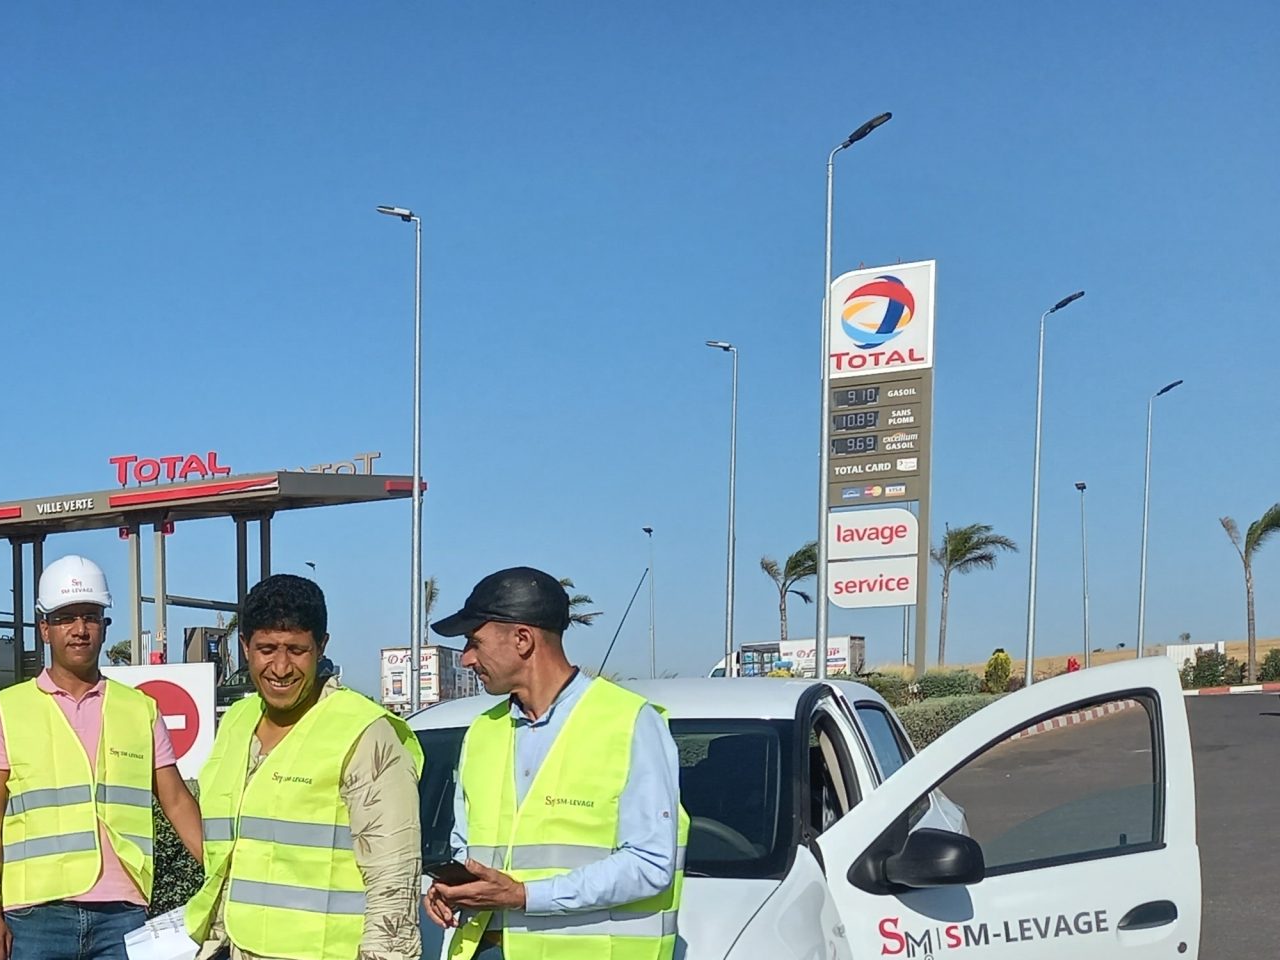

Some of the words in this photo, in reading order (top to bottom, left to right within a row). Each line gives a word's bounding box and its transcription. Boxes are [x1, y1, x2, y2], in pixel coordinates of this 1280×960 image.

[830, 348, 925, 371] TOTAL
[848, 388, 876, 403] 9.10
[887, 387, 917, 398] GASOIL
[888, 416, 915, 425] PLOMB
[891, 408, 912, 418] SANS
[847, 436, 875, 451] 9.69
[885, 441, 914, 450] GASOIL
[109, 451, 231, 485] TOTAL
[834, 464, 864, 475] TOTAL
[865, 462, 892, 473] CARD
[37, 502, 63, 514] VILLE
[63, 498, 94, 512] VERTE
[836, 524, 908, 545] lavage
[834, 574, 910, 595] service
[945, 909, 1109, 949] SM-LEVAGE
